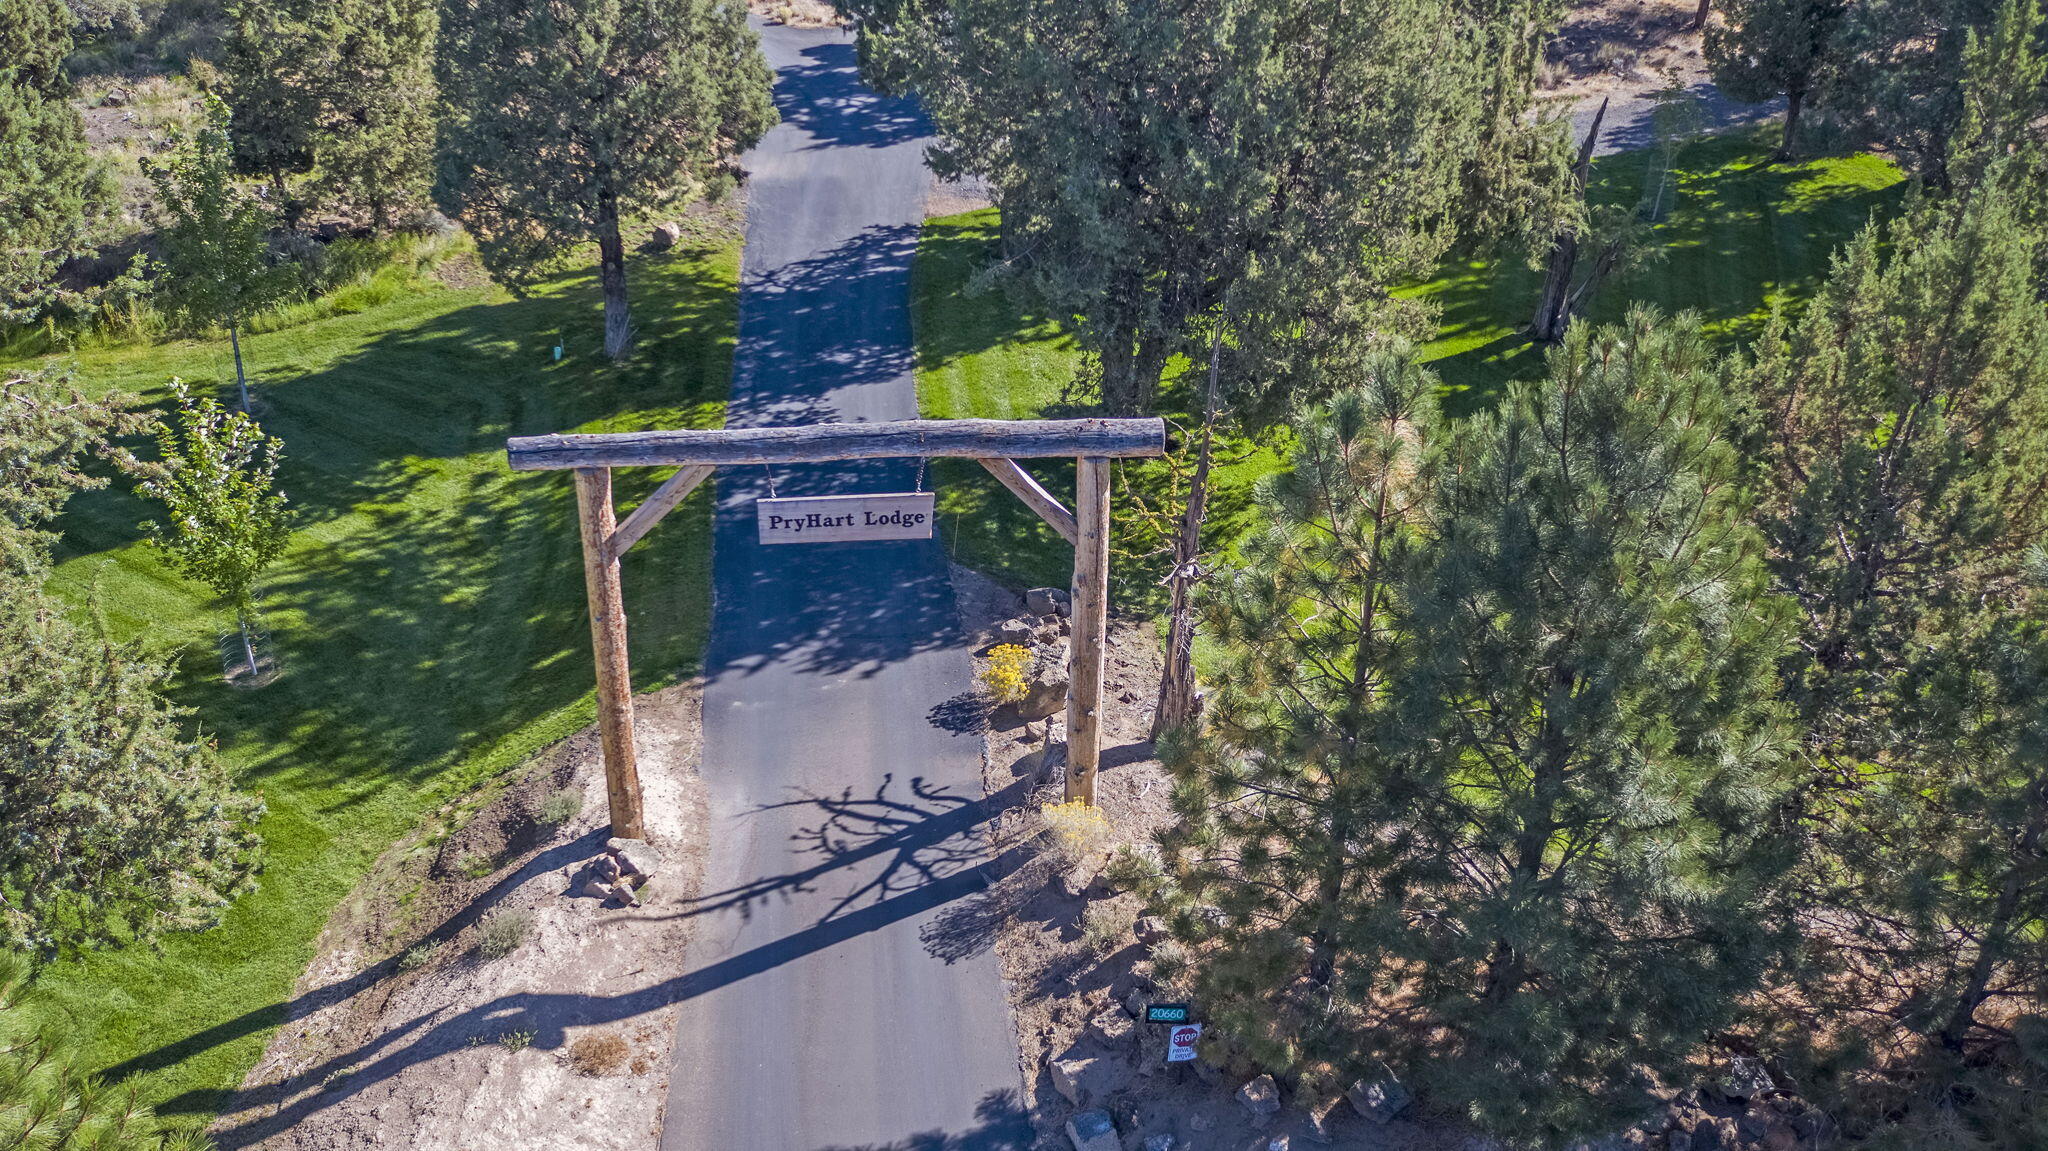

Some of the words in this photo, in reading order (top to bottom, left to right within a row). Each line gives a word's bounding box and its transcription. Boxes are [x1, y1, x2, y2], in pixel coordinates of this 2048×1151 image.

[769, 513, 855, 532] PryHart
[864, 510, 925, 528] Lodge
[1151, 1008, 1184, 1019] 20660
[1174, 1033, 1197, 1043] STOP
